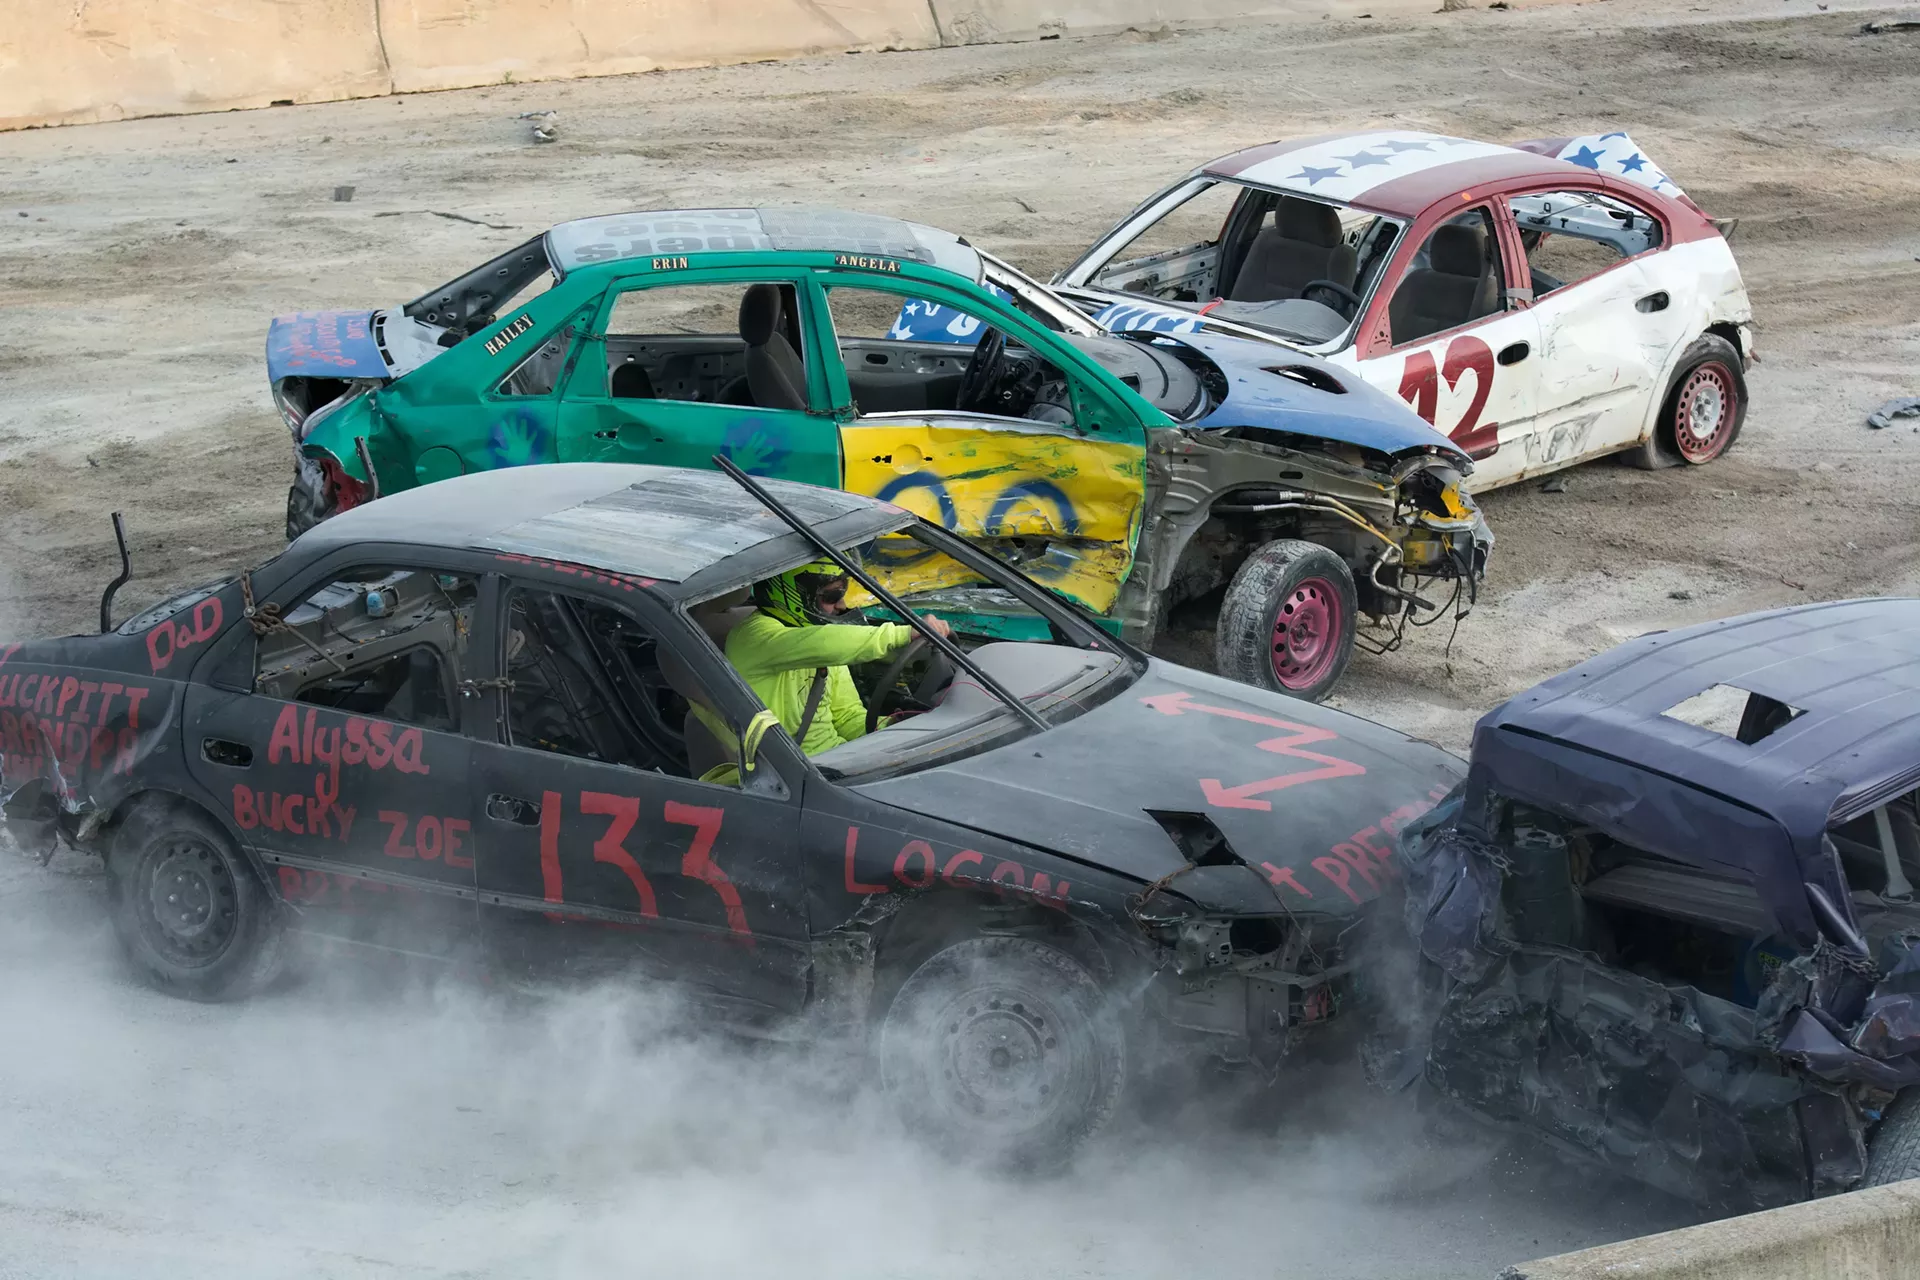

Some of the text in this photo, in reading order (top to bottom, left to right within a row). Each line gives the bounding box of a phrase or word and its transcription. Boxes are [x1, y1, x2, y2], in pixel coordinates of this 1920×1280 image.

[652, 256, 688, 270] ERIN
[839, 255, 897, 273] ANGELA
[484, 313, 534, 356] HAILEY
[1398, 335, 1499, 461] 12
[0, 710, 138, 776] RANDPA
[268, 704, 430, 805] Alyssa
[233, 783, 474, 868] BUCKY ZOE
[540, 790, 753, 946] 133
